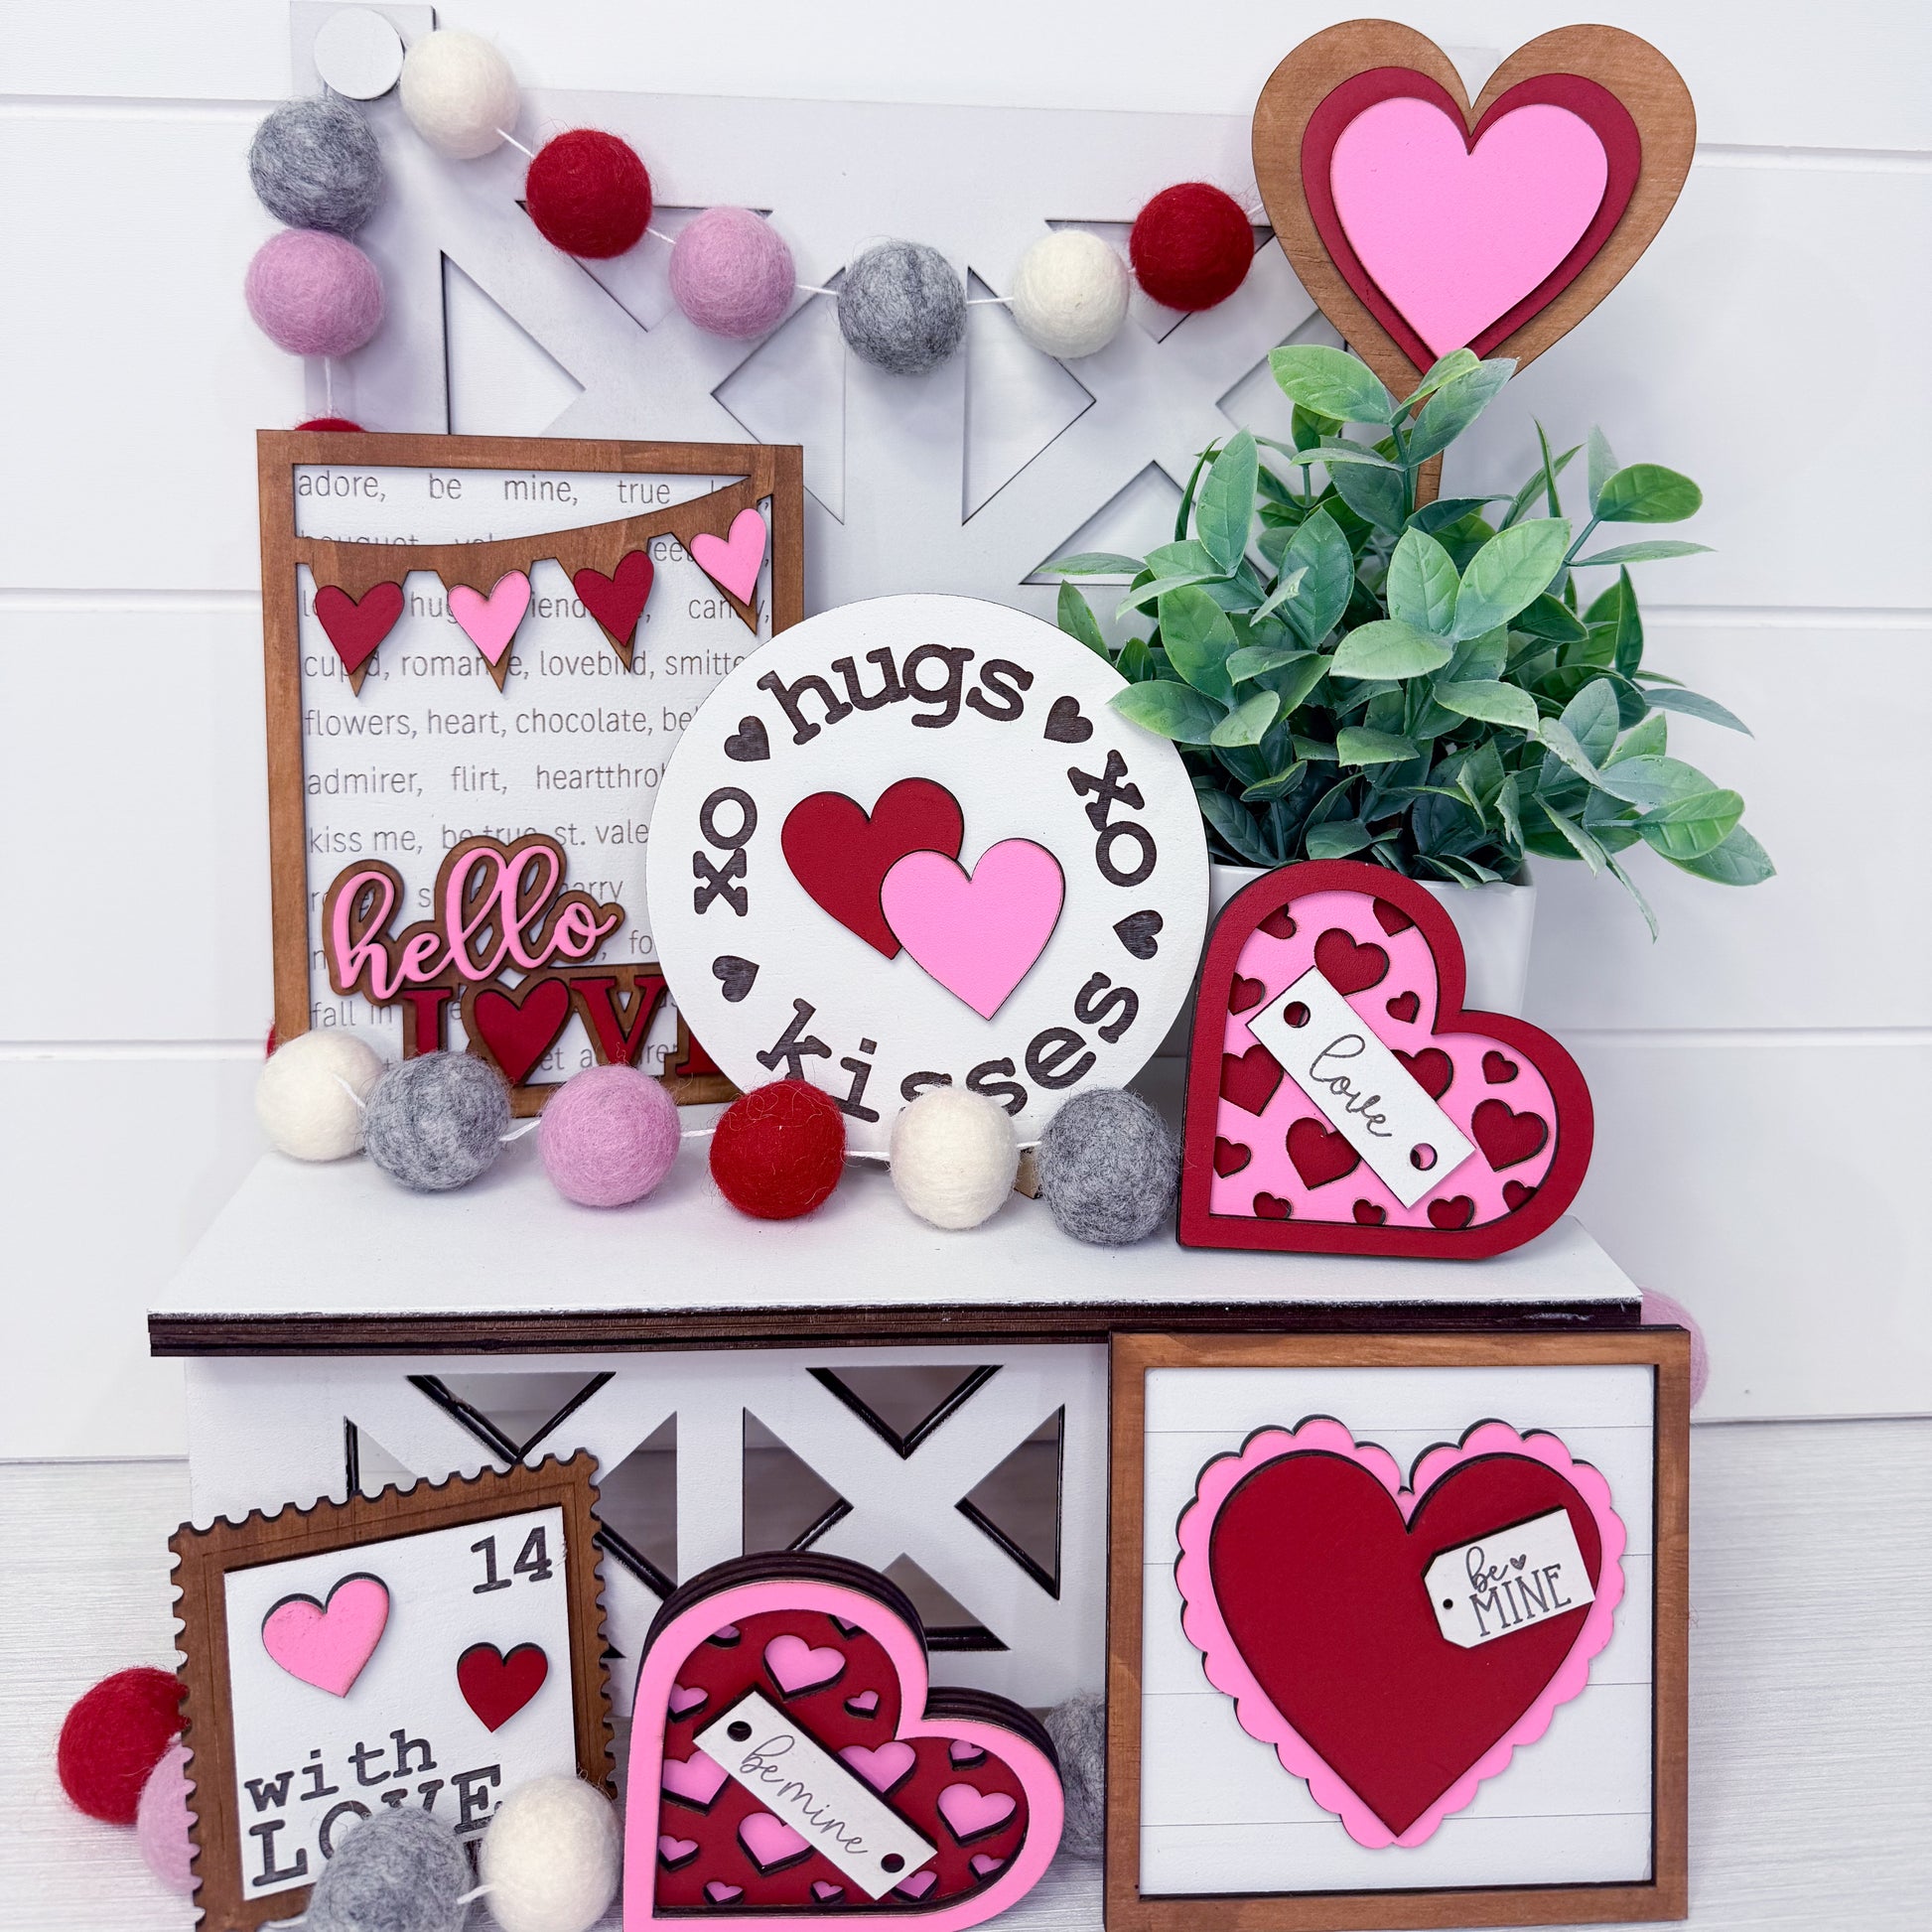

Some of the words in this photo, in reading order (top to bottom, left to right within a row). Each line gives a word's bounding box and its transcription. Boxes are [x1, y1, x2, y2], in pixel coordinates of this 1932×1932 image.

[298, 470, 385, 502] adore,
[430, 473, 462, 499] be
[504, 475, 578, 506] mine,
[618, 480, 671, 504] true
[688, 599, 769, 623] can,
[305, 650, 389, 682] cud,
[402, 654, 529, 680] romane,
[540, 650, 654, 680] lovebid,
[665, 649, 746, 675] smitte
[757, 643, 1035, 746] hugs
[305, 709, 417, 739] flowers,
[428, 709, 507, 738] heart,
[515, 707, 652, 736] chocolate,
[308, 765, 423, 797] admirer,
[451, 764, 507, 795] flirt,
[310, 825, 362, 854] kiss
[374, 830, 423, 855] me,
[554, 823, 586, 846] st.
[596, 819, 649, 844] vale
[333, 845, 618, 1000] hello
[311, 1001, 356, 1028] fall
[1309, 1034, 1392, 1137] love
[471, 1525, 553, 1594] 14
[1465, 1546, 1508, 1593] be
[1468, 1564, 1572, 1637] MINE
[244, 1728, 438, 1813] with
